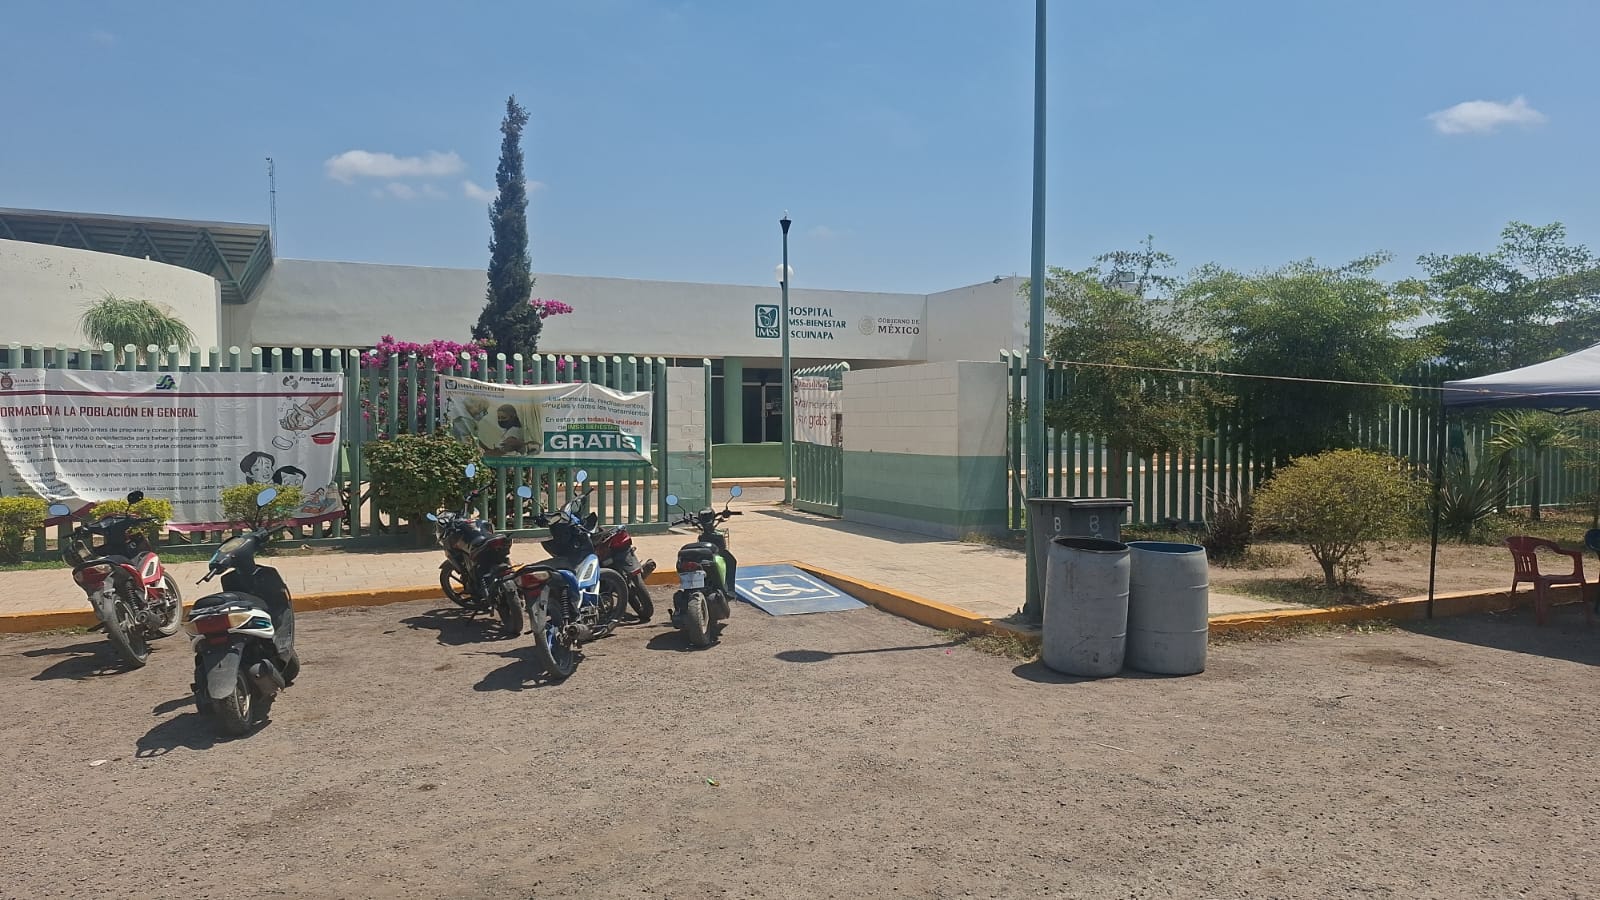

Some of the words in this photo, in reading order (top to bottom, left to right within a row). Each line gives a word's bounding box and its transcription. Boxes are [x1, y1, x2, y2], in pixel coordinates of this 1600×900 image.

[789, 319, 846, 328] MSS-BIENESTAR
[757, 328, 779, 337] IMSS
[878, 324, 920, 335] MÉXICO
[791, 331, 834, 340] SCUINAPA
[55, 406, 61, 417] A
[64, 406, 76, 417] LA
[80, 406, 138, 417] POBLACIÓN
[142, 408, 154, 417] EN
[158, 408, 198, 417] GENERAL
[550, 434, 637, 449] GRATIS
[1054, 516, 1062, 531] B
